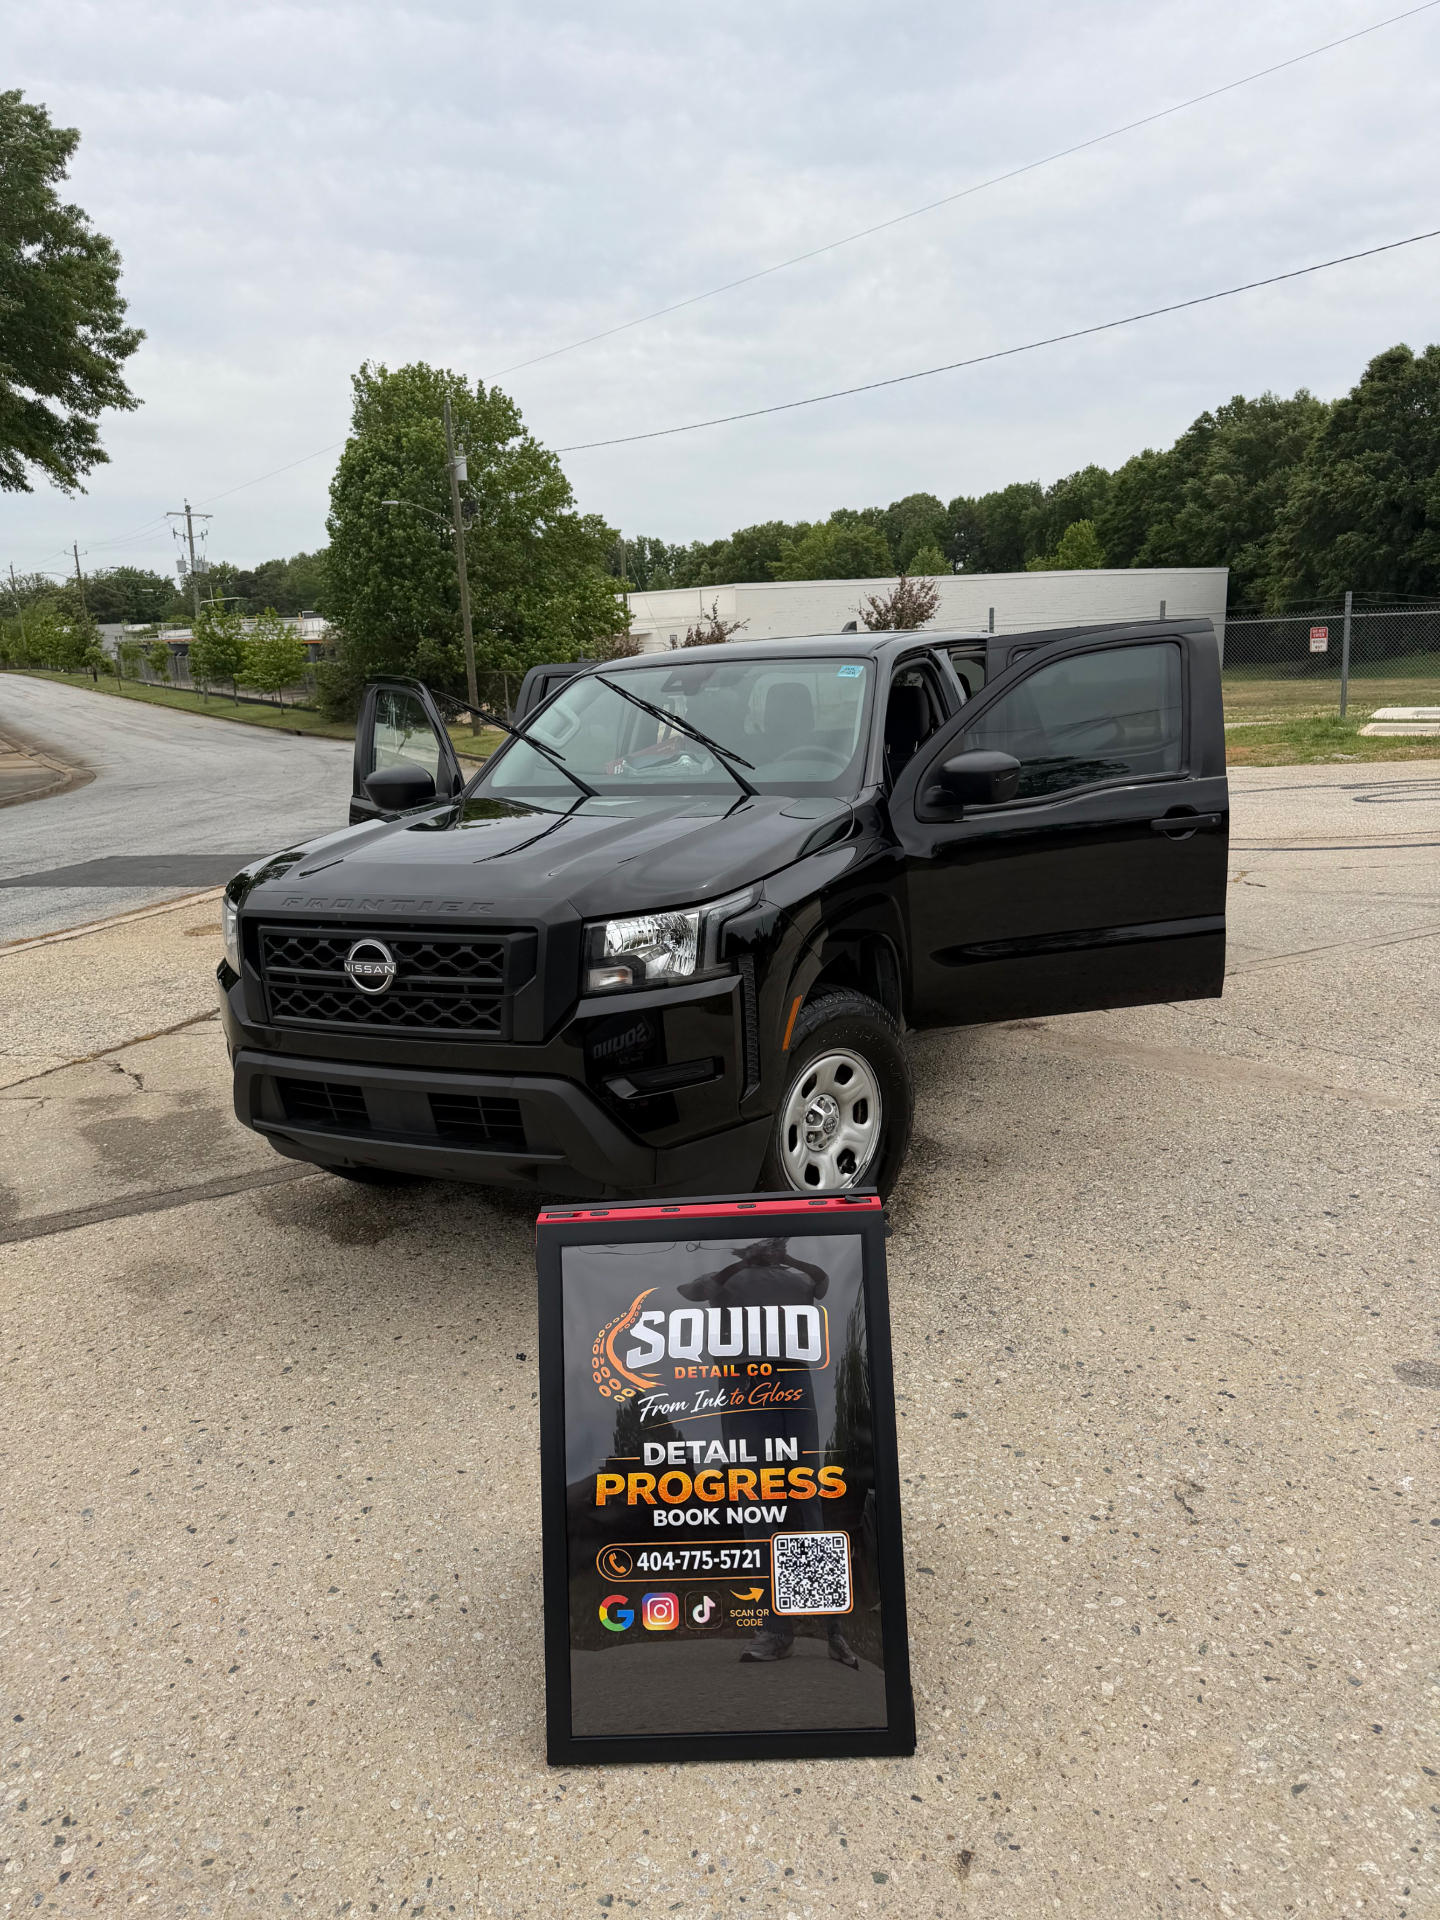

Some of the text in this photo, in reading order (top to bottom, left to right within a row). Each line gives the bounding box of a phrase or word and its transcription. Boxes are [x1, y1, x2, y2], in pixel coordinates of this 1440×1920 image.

[281, 897, 495, 914] FRONTIER
[344, 962, 395, 974] NISSAN
[674, 1363, 772, 1379] DETAIL CO
[638, 1382, 805, 1423] From Ink to Gloss
[643, 1437, 798, 1466] DETAIL IN
[595, 1465, 847, 1506] PROGRESS
[653, 1505, 787, 1527] BOOK NOW
[636, 1549, 761, 1571] 404-775-5721
[729, 1608, 770, 1618] SCAN QR
[736, 1618, 763, 1627] CODE
